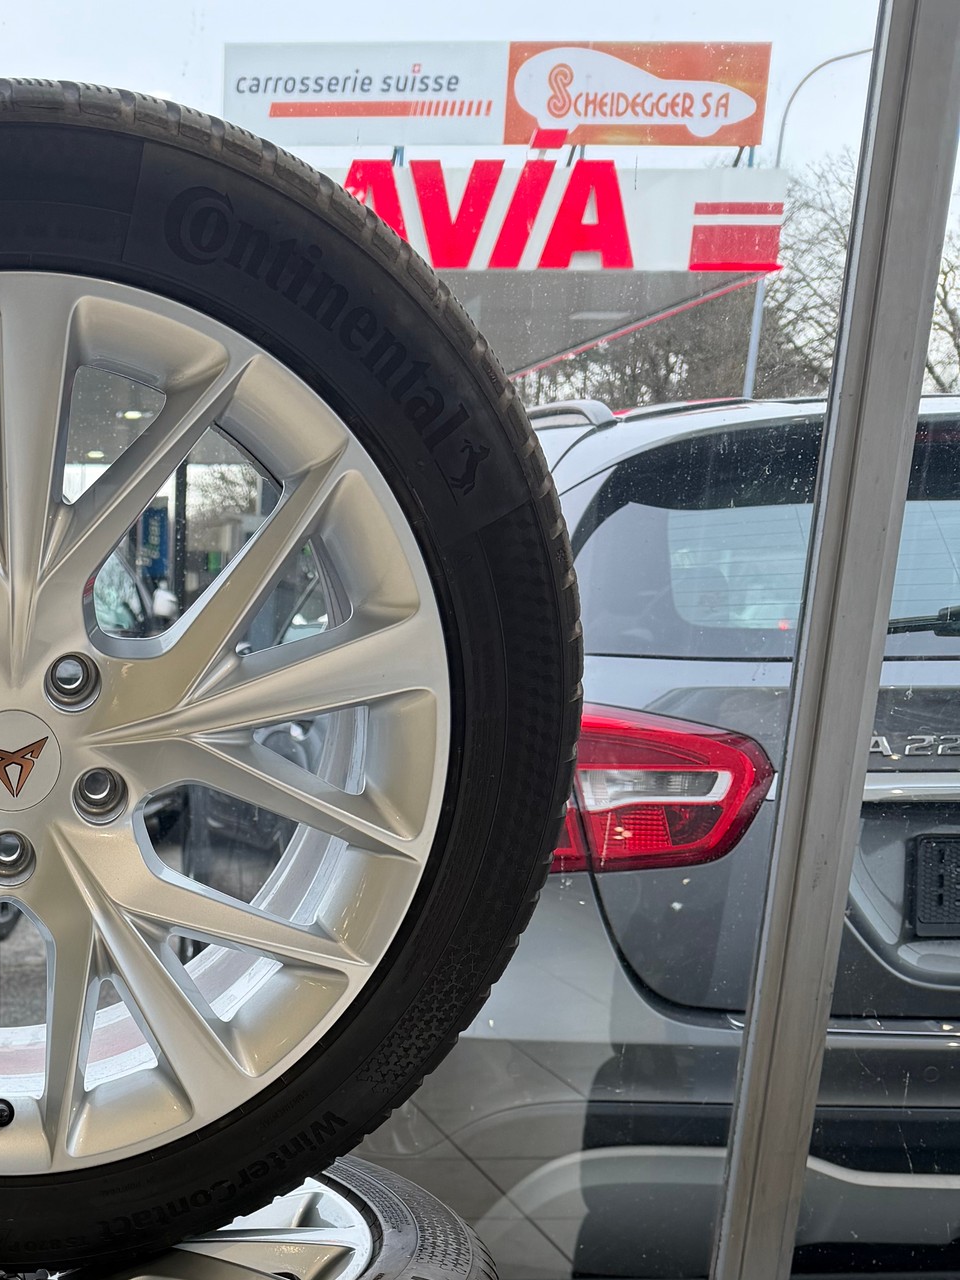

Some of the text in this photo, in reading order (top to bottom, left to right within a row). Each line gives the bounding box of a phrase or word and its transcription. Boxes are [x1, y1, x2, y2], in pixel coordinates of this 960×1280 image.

[236, 63, 460, 94] carrosserie suisse
[164, 185, 472, 454] Continental
[97, 1109, 349, 1244] WinterContact
